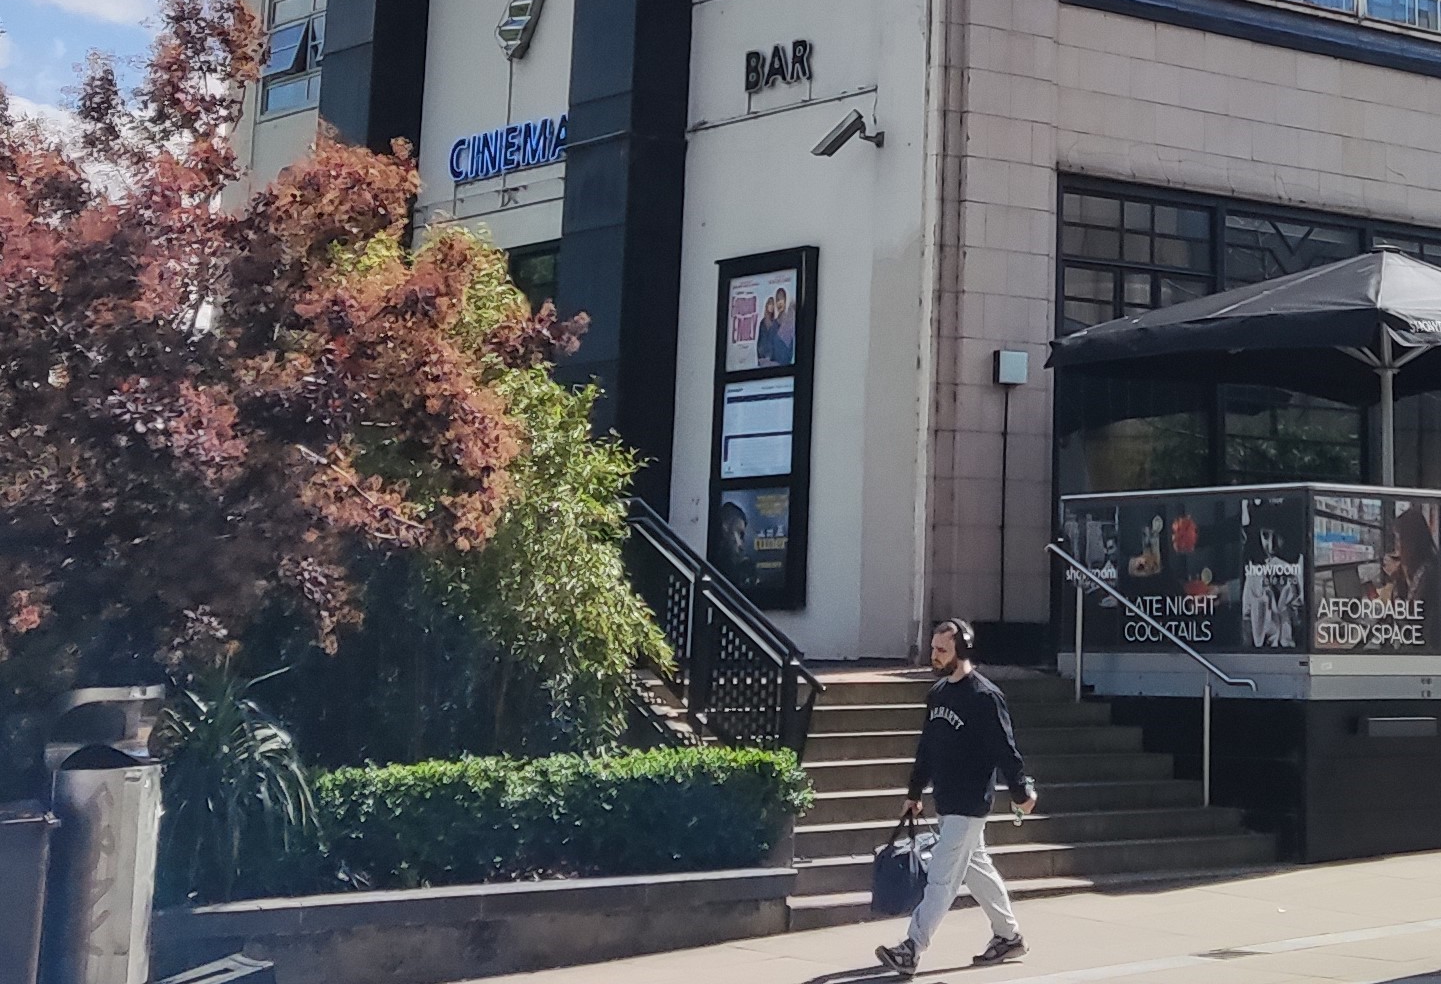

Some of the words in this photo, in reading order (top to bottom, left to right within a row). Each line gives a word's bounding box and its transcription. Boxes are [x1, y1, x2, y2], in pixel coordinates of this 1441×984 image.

[744, 38, 813, 92] BAR
[449, 114, 568, 182] CINEMA
[1244, 560, 1300, 576] showroom
[1125, 595, 1163, 616] LATE
[1166, 594, 1217, 616] NIGHT
[1317, 597, 1425, 620] AFFORDABLE
[1317, 623, 1370, 644] STUDY
